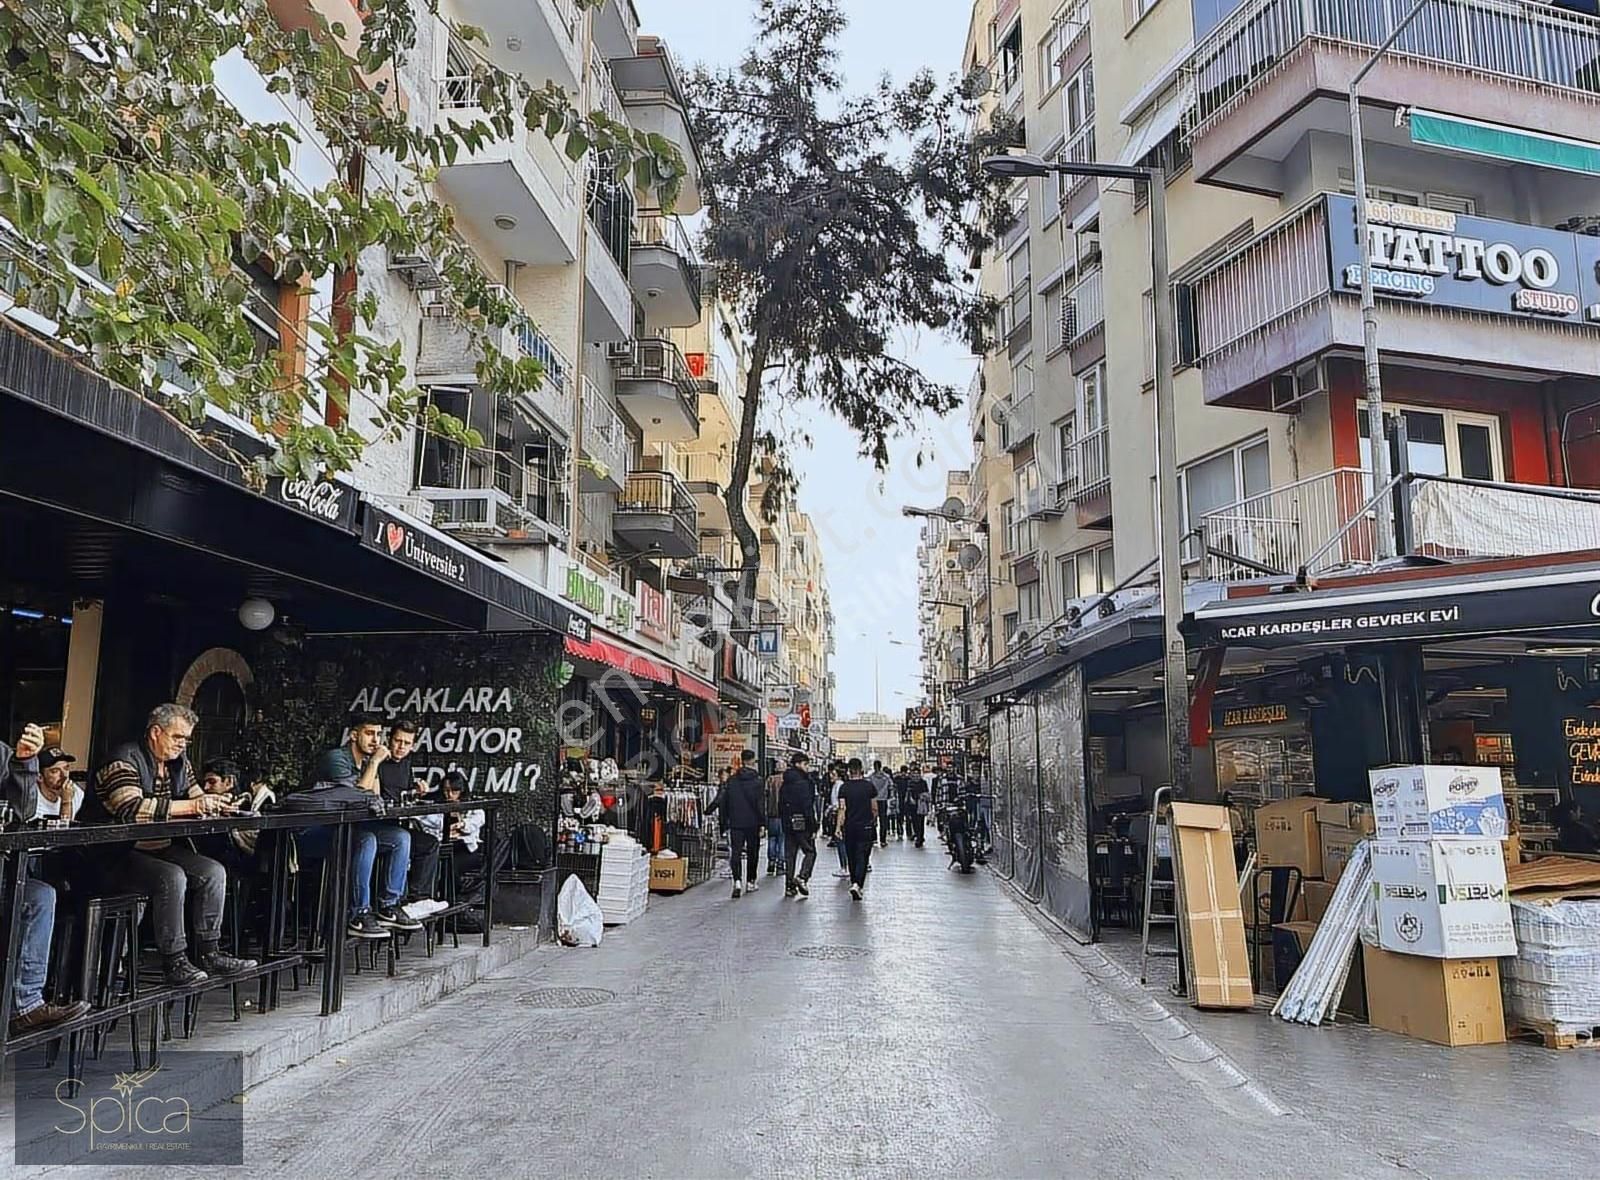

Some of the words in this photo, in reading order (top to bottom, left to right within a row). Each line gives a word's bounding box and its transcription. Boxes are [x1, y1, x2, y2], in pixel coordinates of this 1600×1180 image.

[1367, 224, 1559, 289] TATTOO
[1352, 267, 1433, 292] PERCING
[1521, 291, 1578, 313] STUDIO
[375, 522, 384, 544] I
[405, 532, 458, 581] Üniversite
[458, 564, 465, 582] 2
[1221, 626, 1256, 639] ACAR
[1260, 618, 1353, 636] KARDEŞLER
[1356, 611, 1425, 629] GEVREK
[1430, 605, 1459, 623] EVİ
[349, 687, 513, 719] ALÇAKLARA
[413, 722, 523, 754] AĞIYOR
